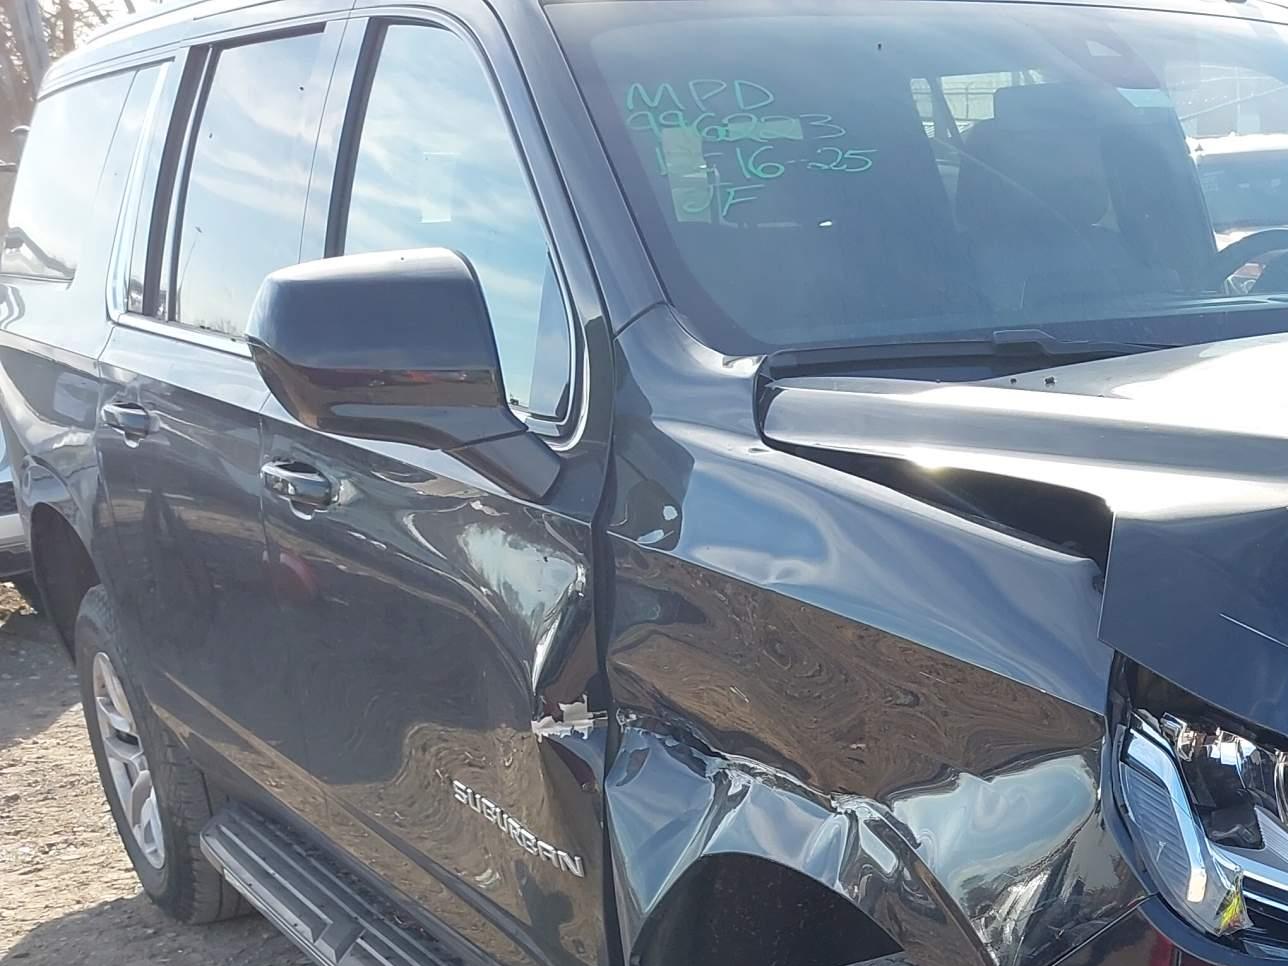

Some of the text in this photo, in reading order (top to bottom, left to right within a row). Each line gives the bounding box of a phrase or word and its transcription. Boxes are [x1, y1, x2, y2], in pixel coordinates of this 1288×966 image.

[626, 79, 775, 111] MPD
[655, 145, 878, 178] 1-16-25
[452, 779, 585, 878] SUBURBAN
